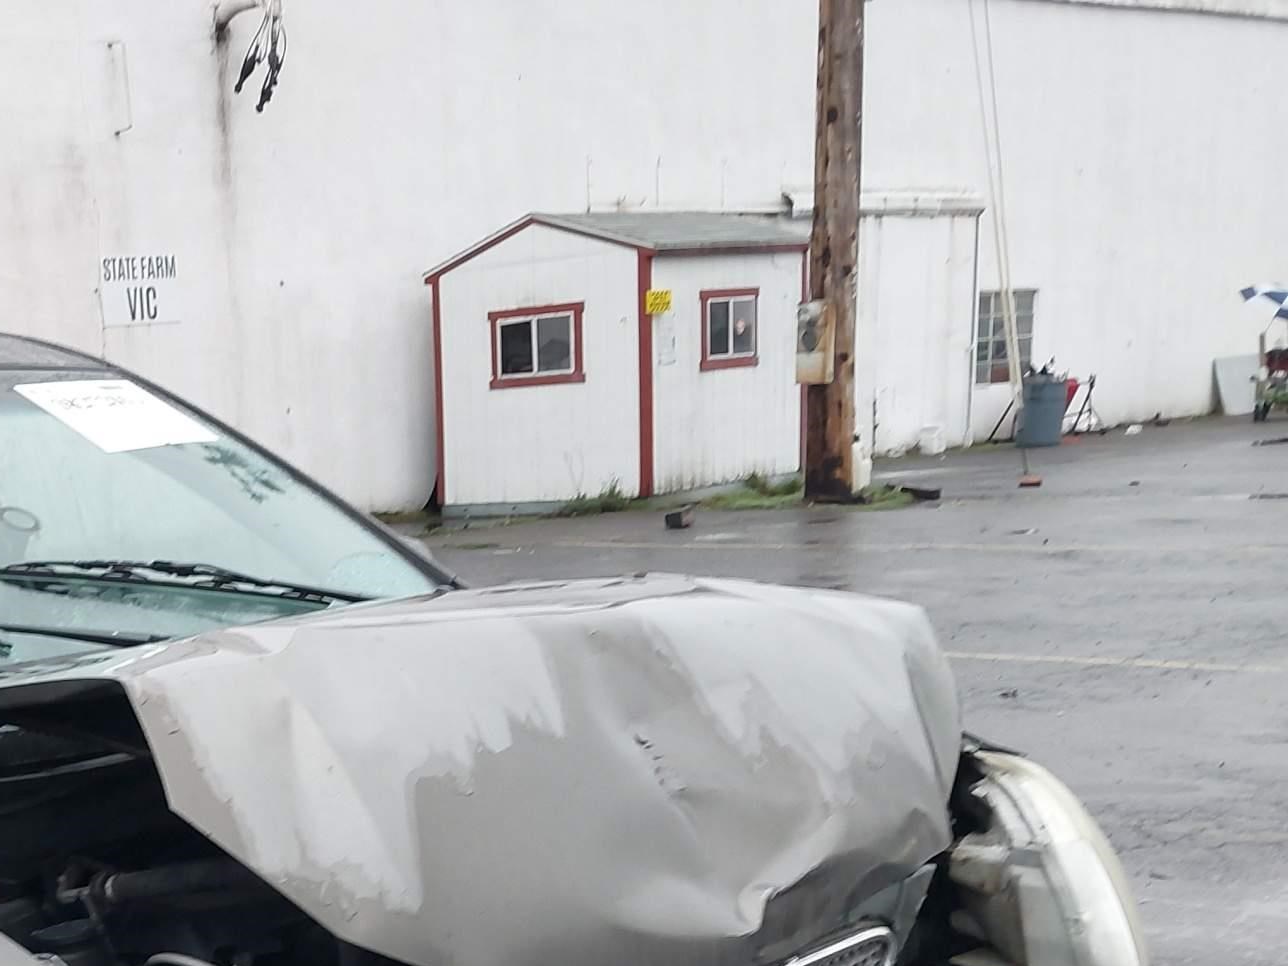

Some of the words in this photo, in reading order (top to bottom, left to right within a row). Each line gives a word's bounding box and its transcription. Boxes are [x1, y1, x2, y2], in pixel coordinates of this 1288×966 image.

[102, 256, 138, 282] STATE
[140, 254, 176, 280] FARM
[126, 285, 158, 322] VIC
